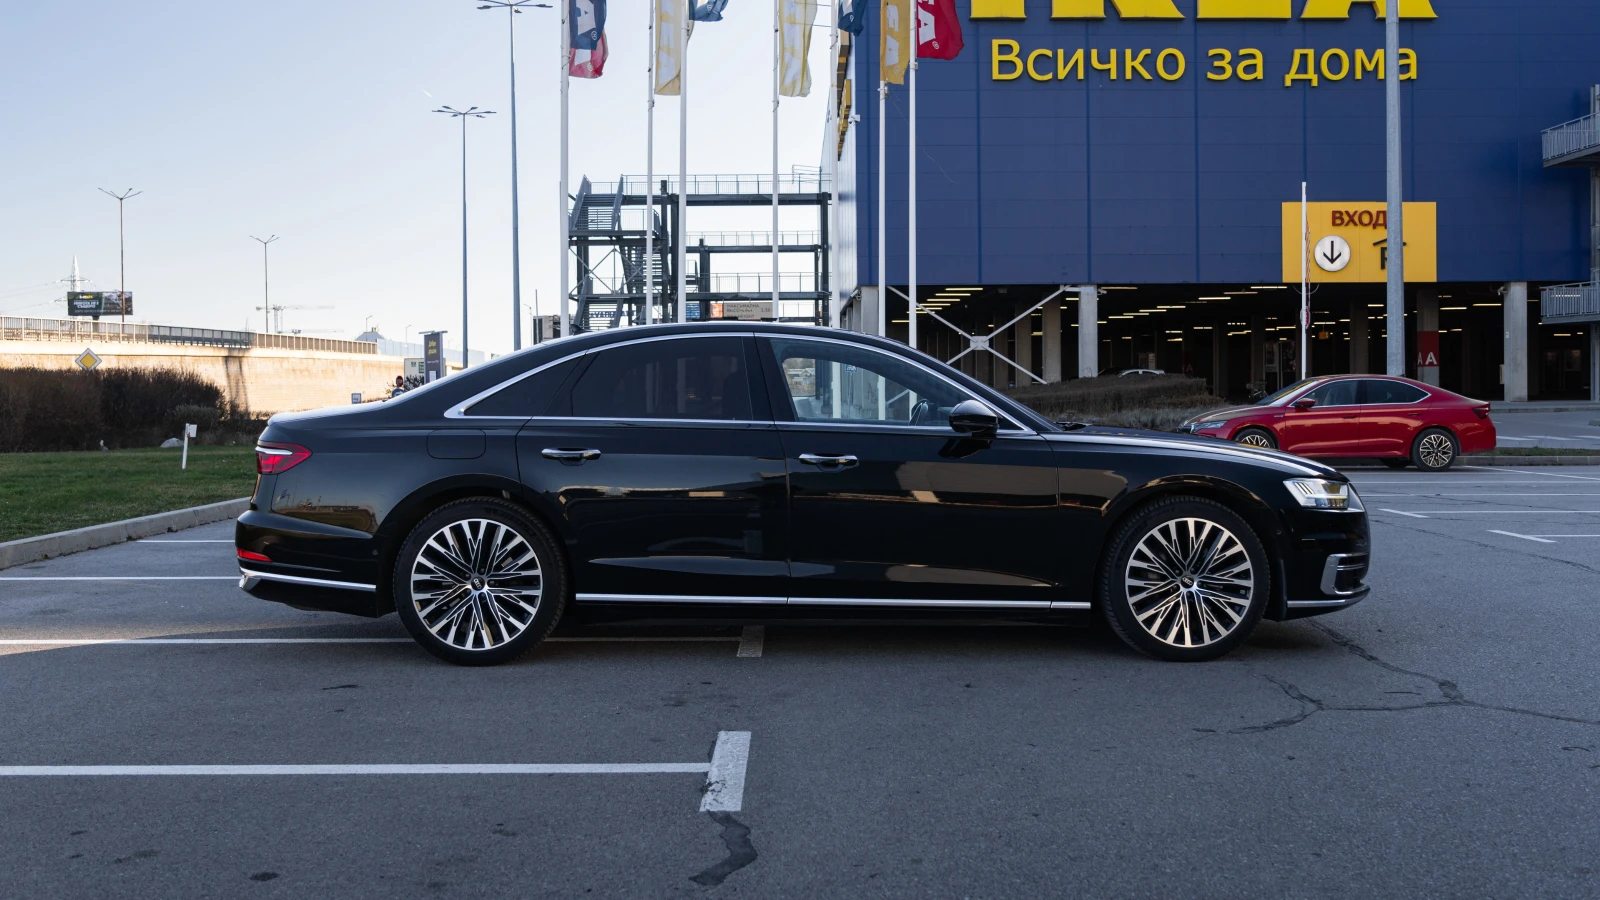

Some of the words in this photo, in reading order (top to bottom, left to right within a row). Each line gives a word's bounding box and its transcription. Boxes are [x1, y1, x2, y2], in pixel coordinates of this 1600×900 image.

[990, 38, 1187, 82] Всичко
[1205, 47, 1264, 82] за
[1284, 47, 1418, 87] дома
[1331, 210, 1388, 230] ВХОД
[1425, 352, 1437, 365] A
